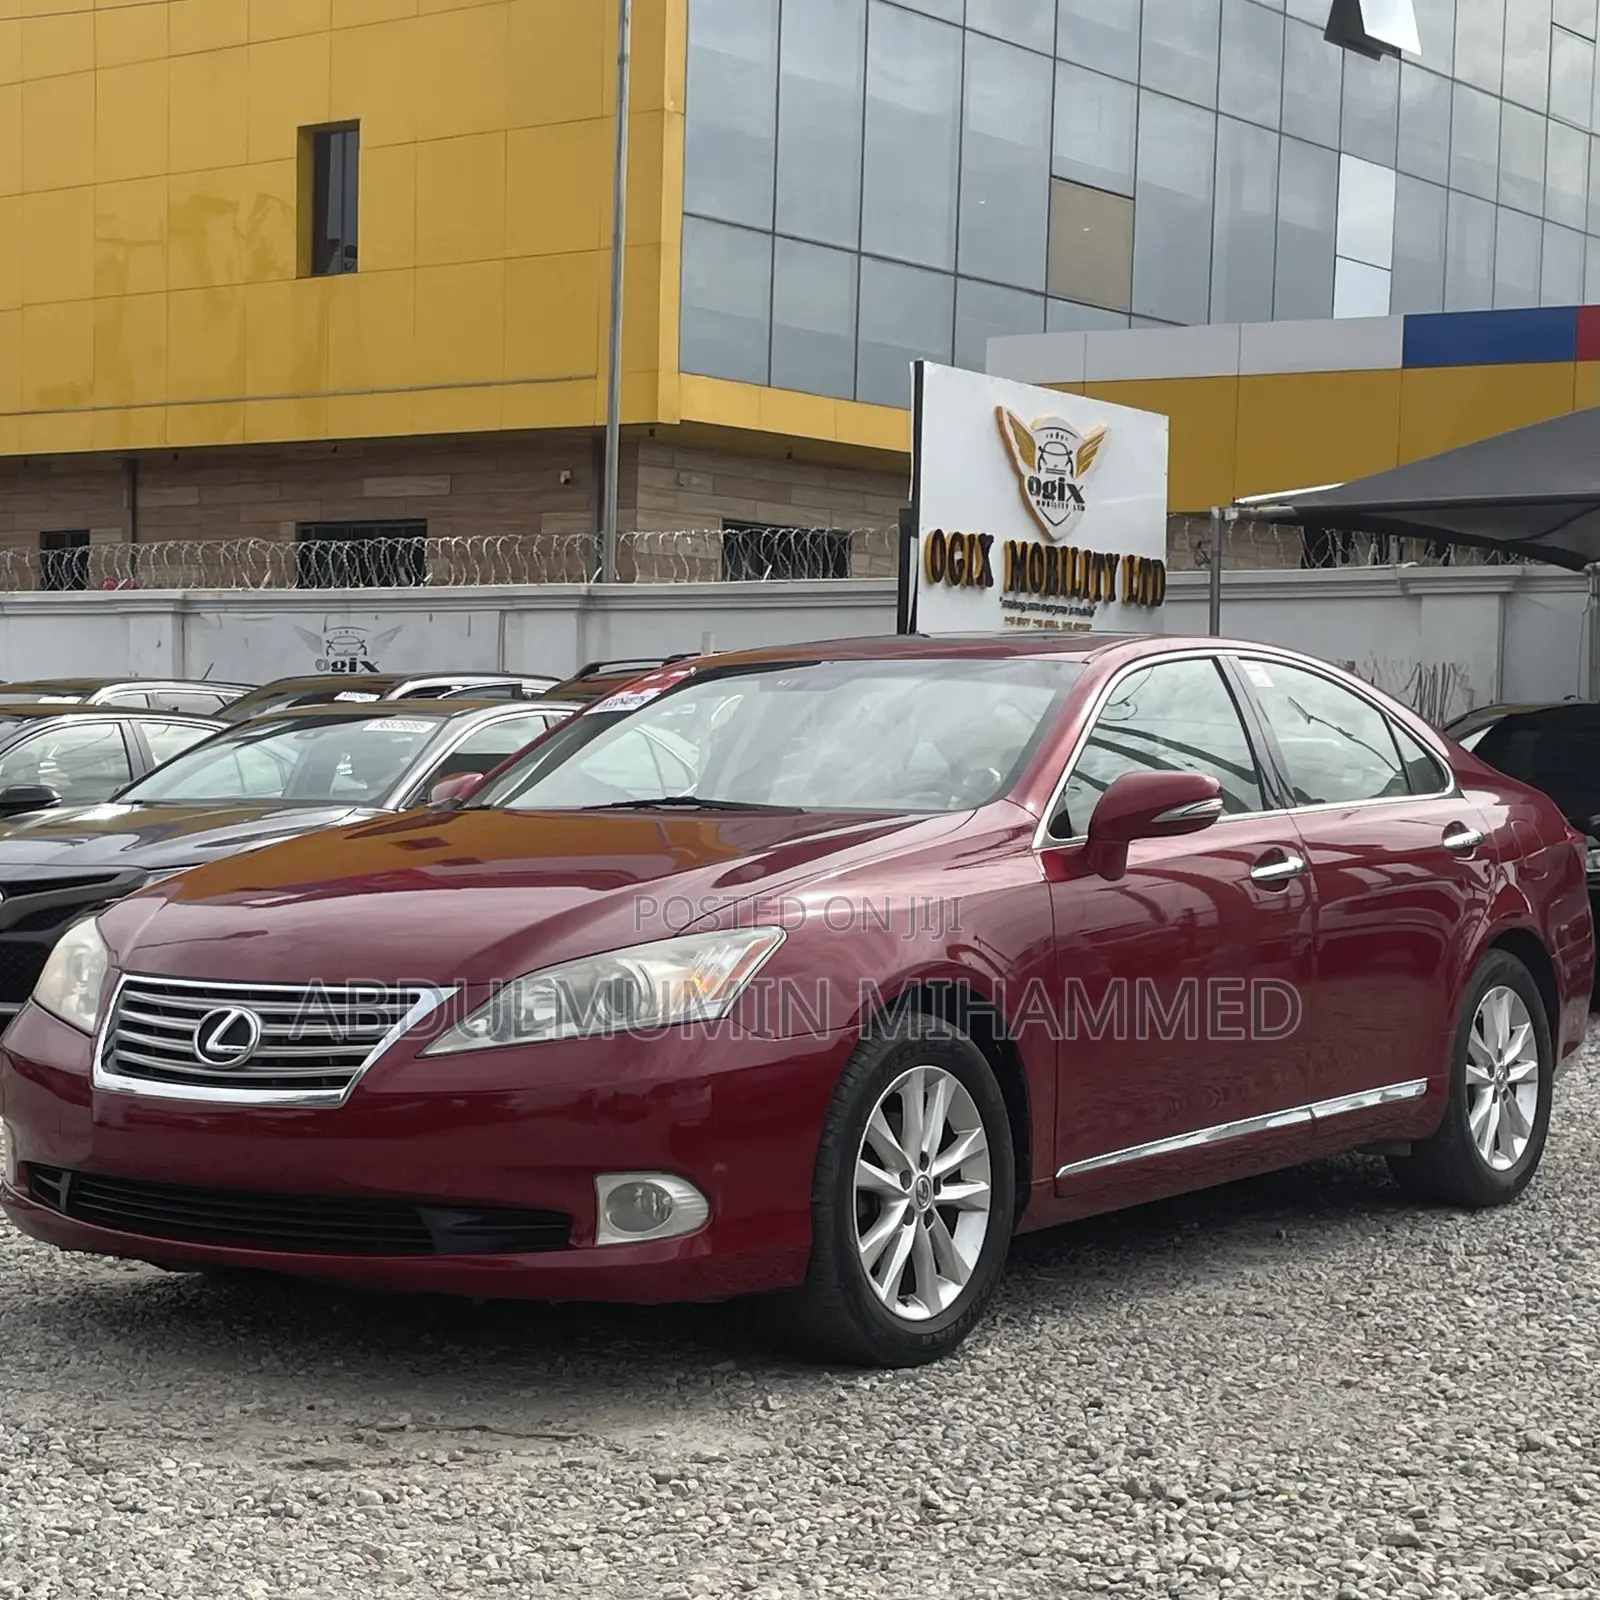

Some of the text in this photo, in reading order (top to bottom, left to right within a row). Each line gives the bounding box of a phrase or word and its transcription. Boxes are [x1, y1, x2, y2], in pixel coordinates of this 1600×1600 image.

[1027, 475, 1085, 504] ogix
[925, 528, 1166, 608] OGIX MOBILITY LTD
[315, 657, 380, 673] ogix
